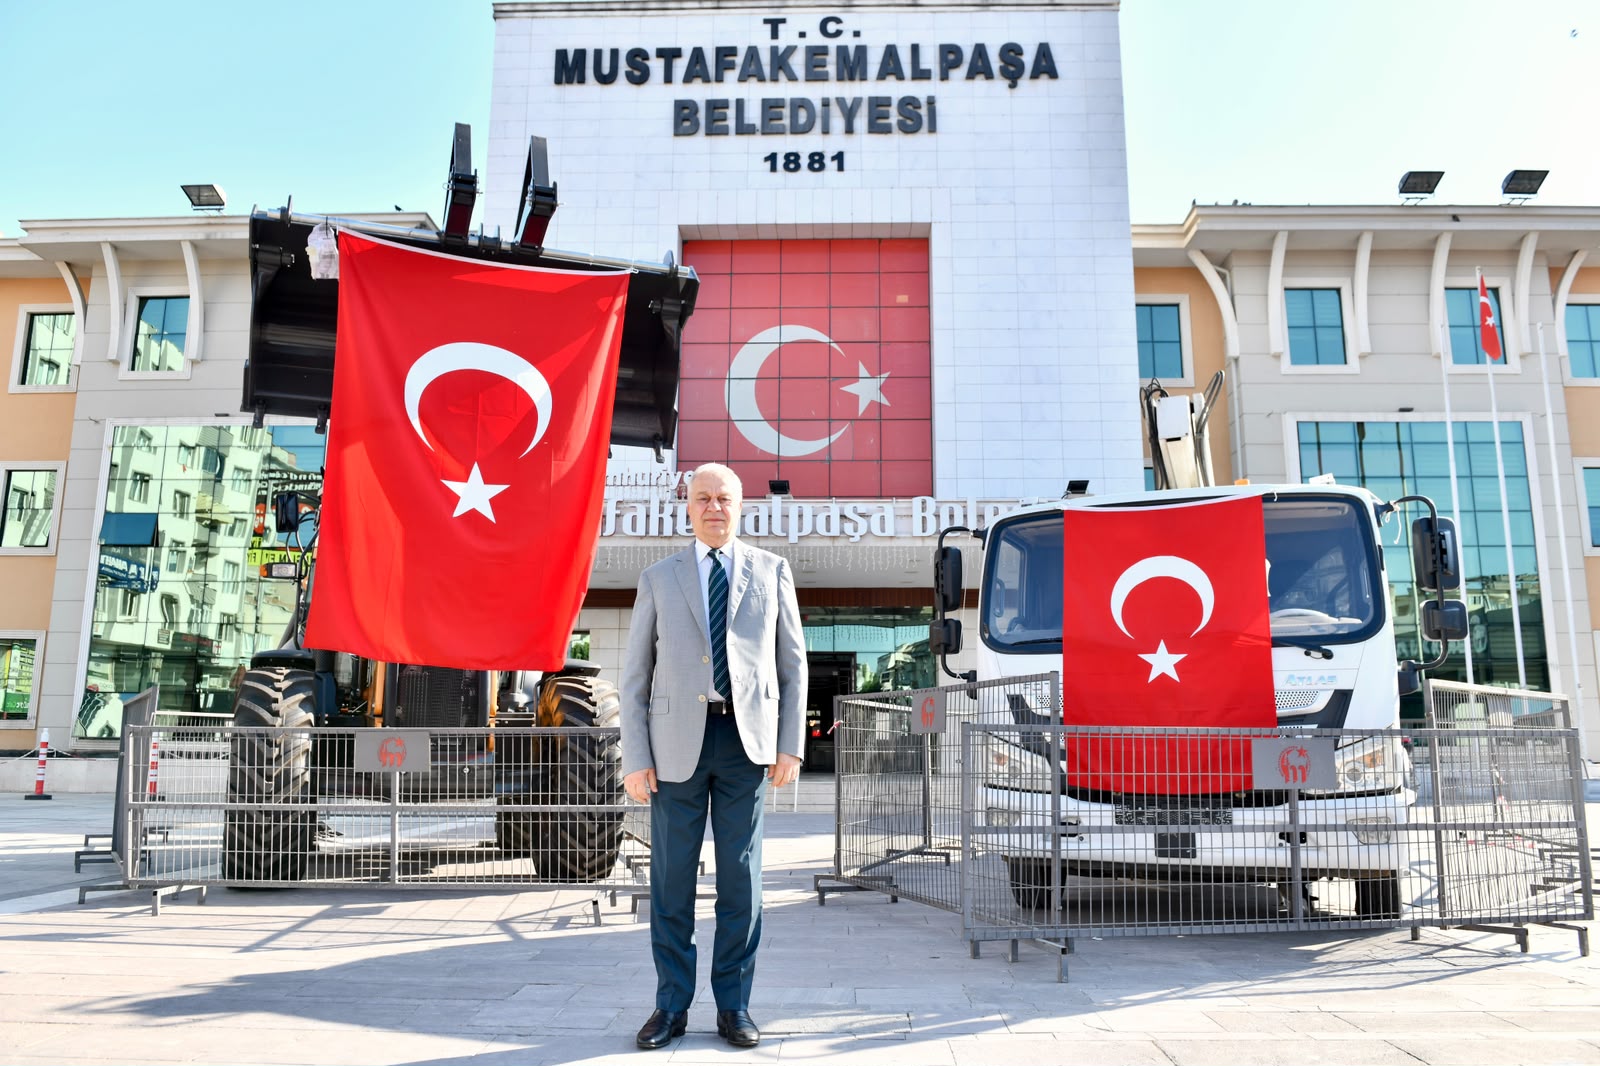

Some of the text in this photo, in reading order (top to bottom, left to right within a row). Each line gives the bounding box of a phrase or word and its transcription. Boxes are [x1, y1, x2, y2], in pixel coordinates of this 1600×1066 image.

[554, 42, 1058, 88] MUSTAFAKEMALPAŞA
[673, 96, 936, 137] BELEDİYESİ
[763, 151, 846, 173] 1881
